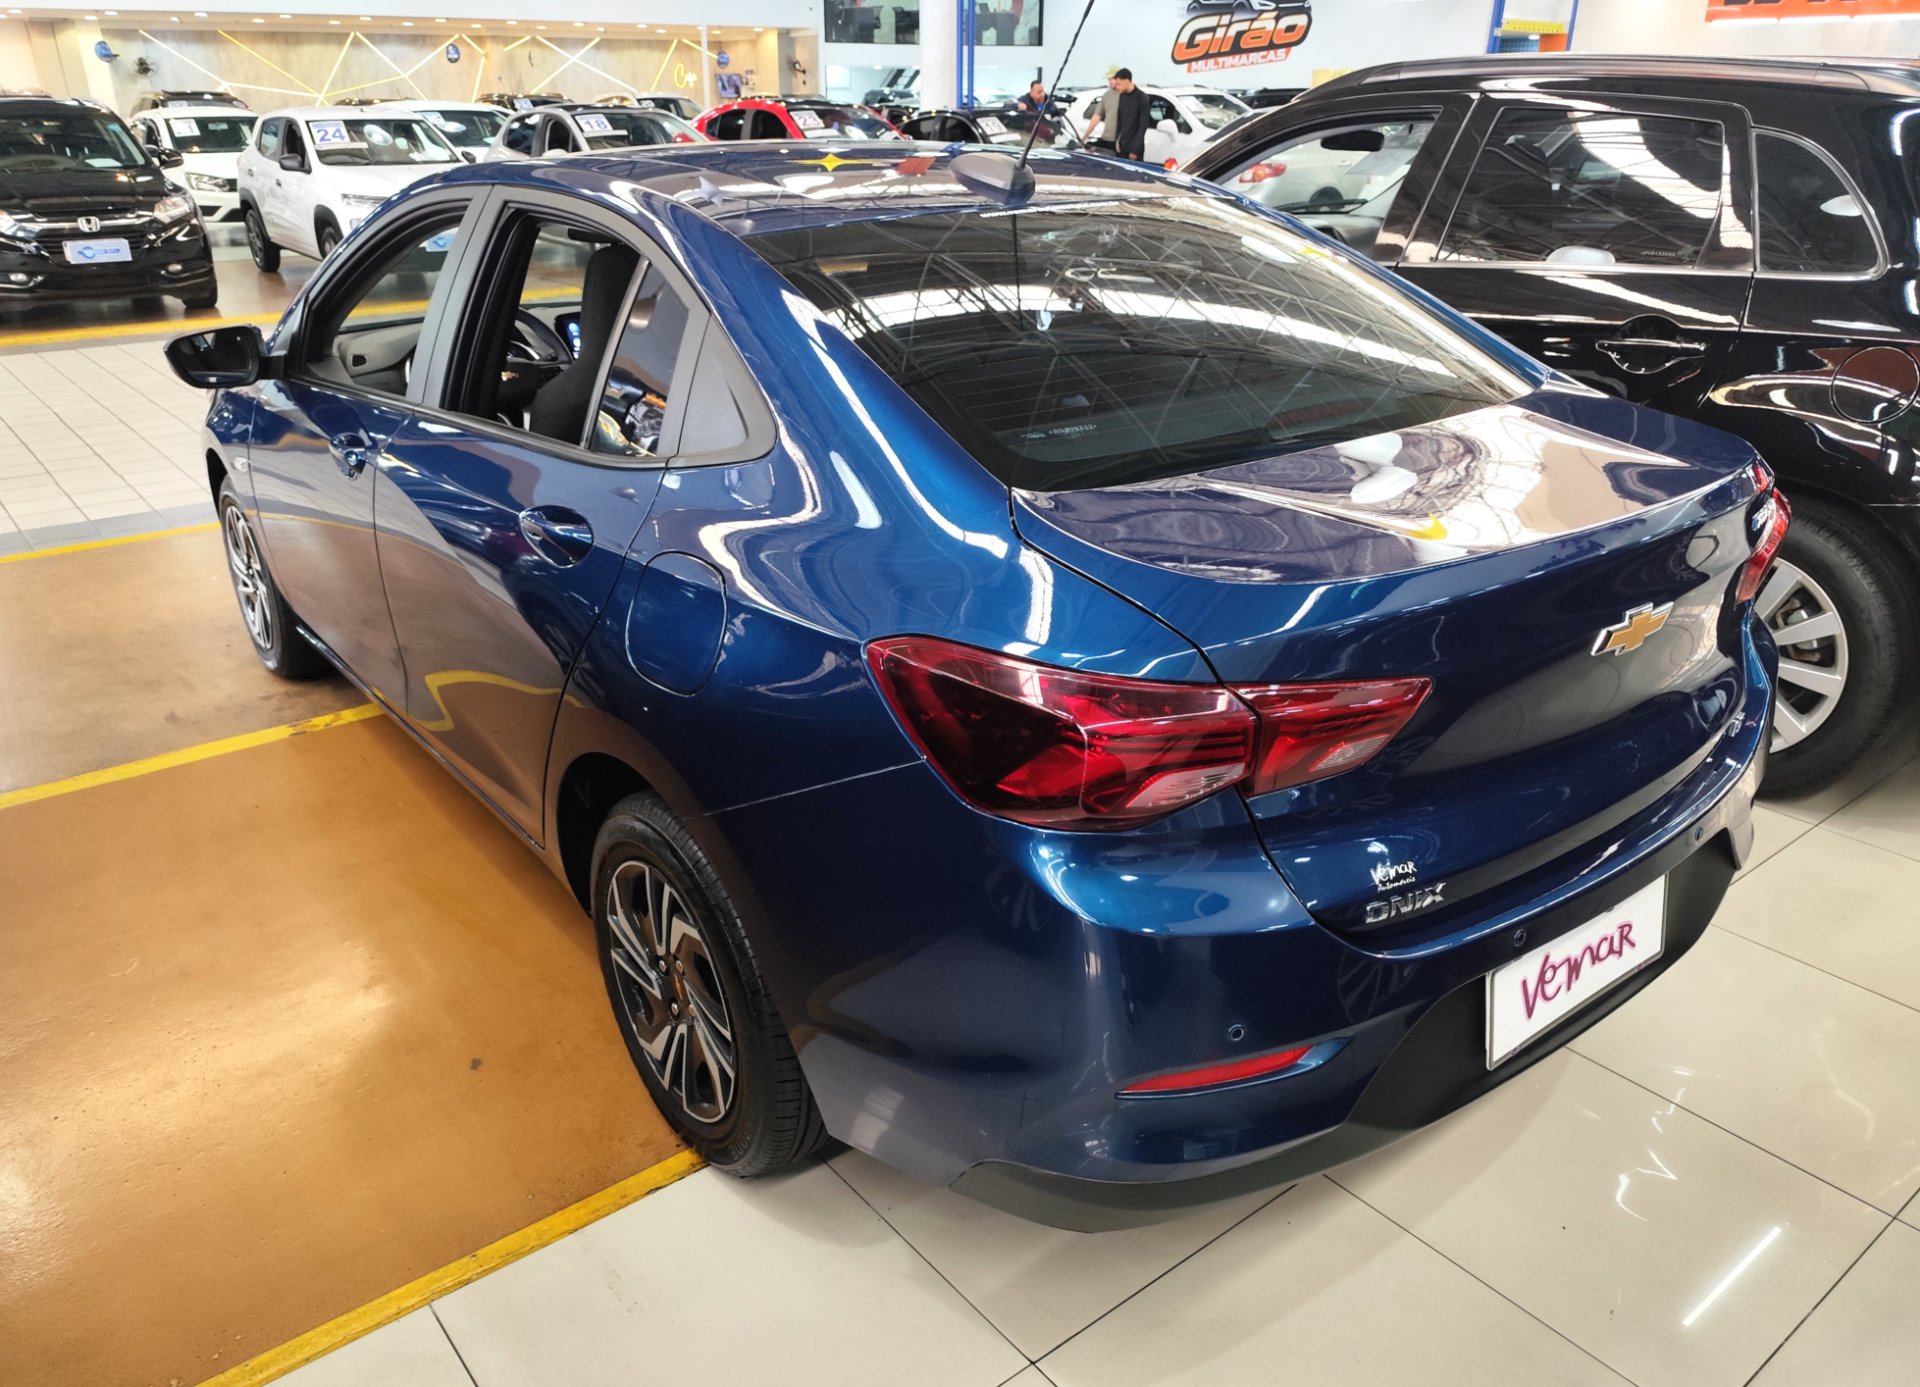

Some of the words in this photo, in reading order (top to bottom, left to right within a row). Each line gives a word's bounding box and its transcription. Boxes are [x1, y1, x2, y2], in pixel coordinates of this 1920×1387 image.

[1190, 48, 1287, 73] MULTIMARCAS
[316, 127, 346, 142] 24
[1365, 882, 1447, 924] ONIX
